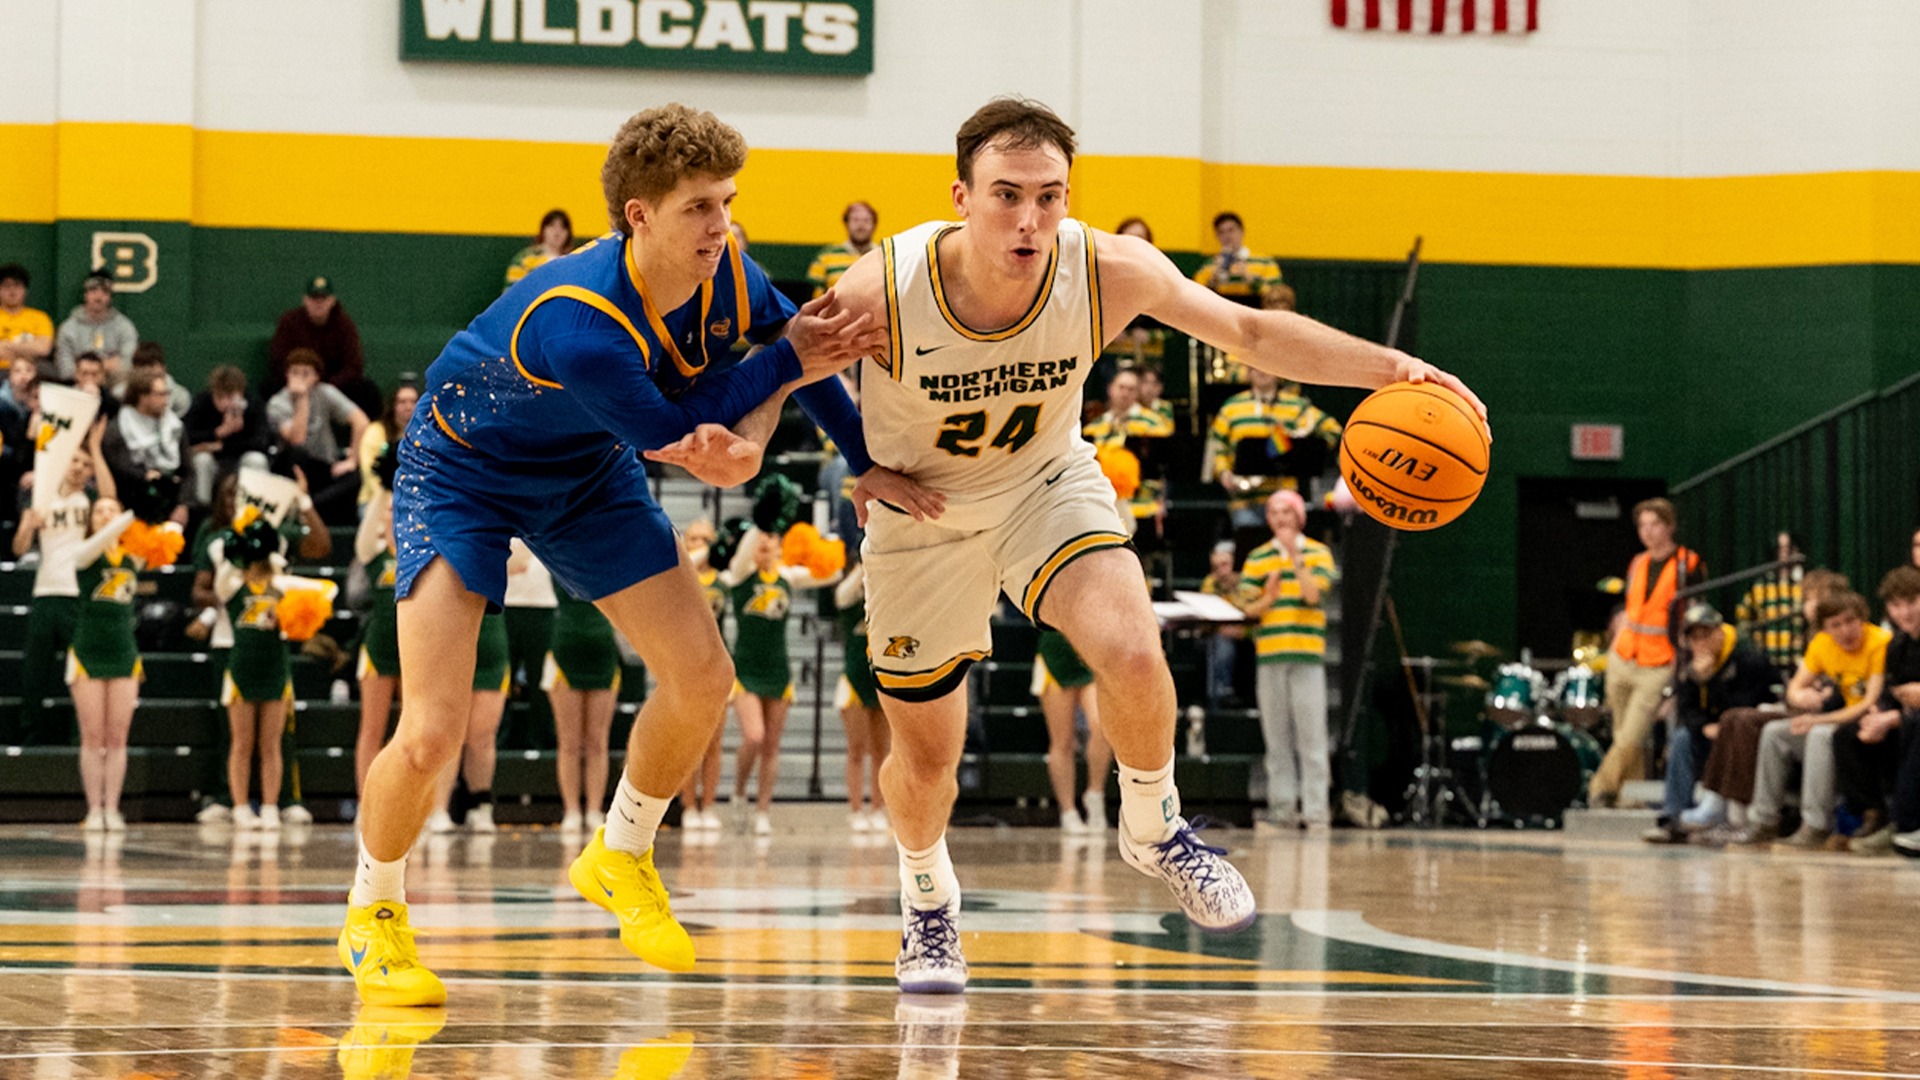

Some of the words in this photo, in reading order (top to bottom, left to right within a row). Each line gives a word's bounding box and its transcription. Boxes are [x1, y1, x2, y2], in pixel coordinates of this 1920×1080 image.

[422, 0, 859, 55] WILDCATS
[919, 356, 1078, 390] NORTHERN
[929, 374, 1069, 403] MICHIGAN
[934, 402, 1044, 458] 24
[1378, 448, 1438, 482] EVO
[1350, 470, 1438, 525] Wilson
